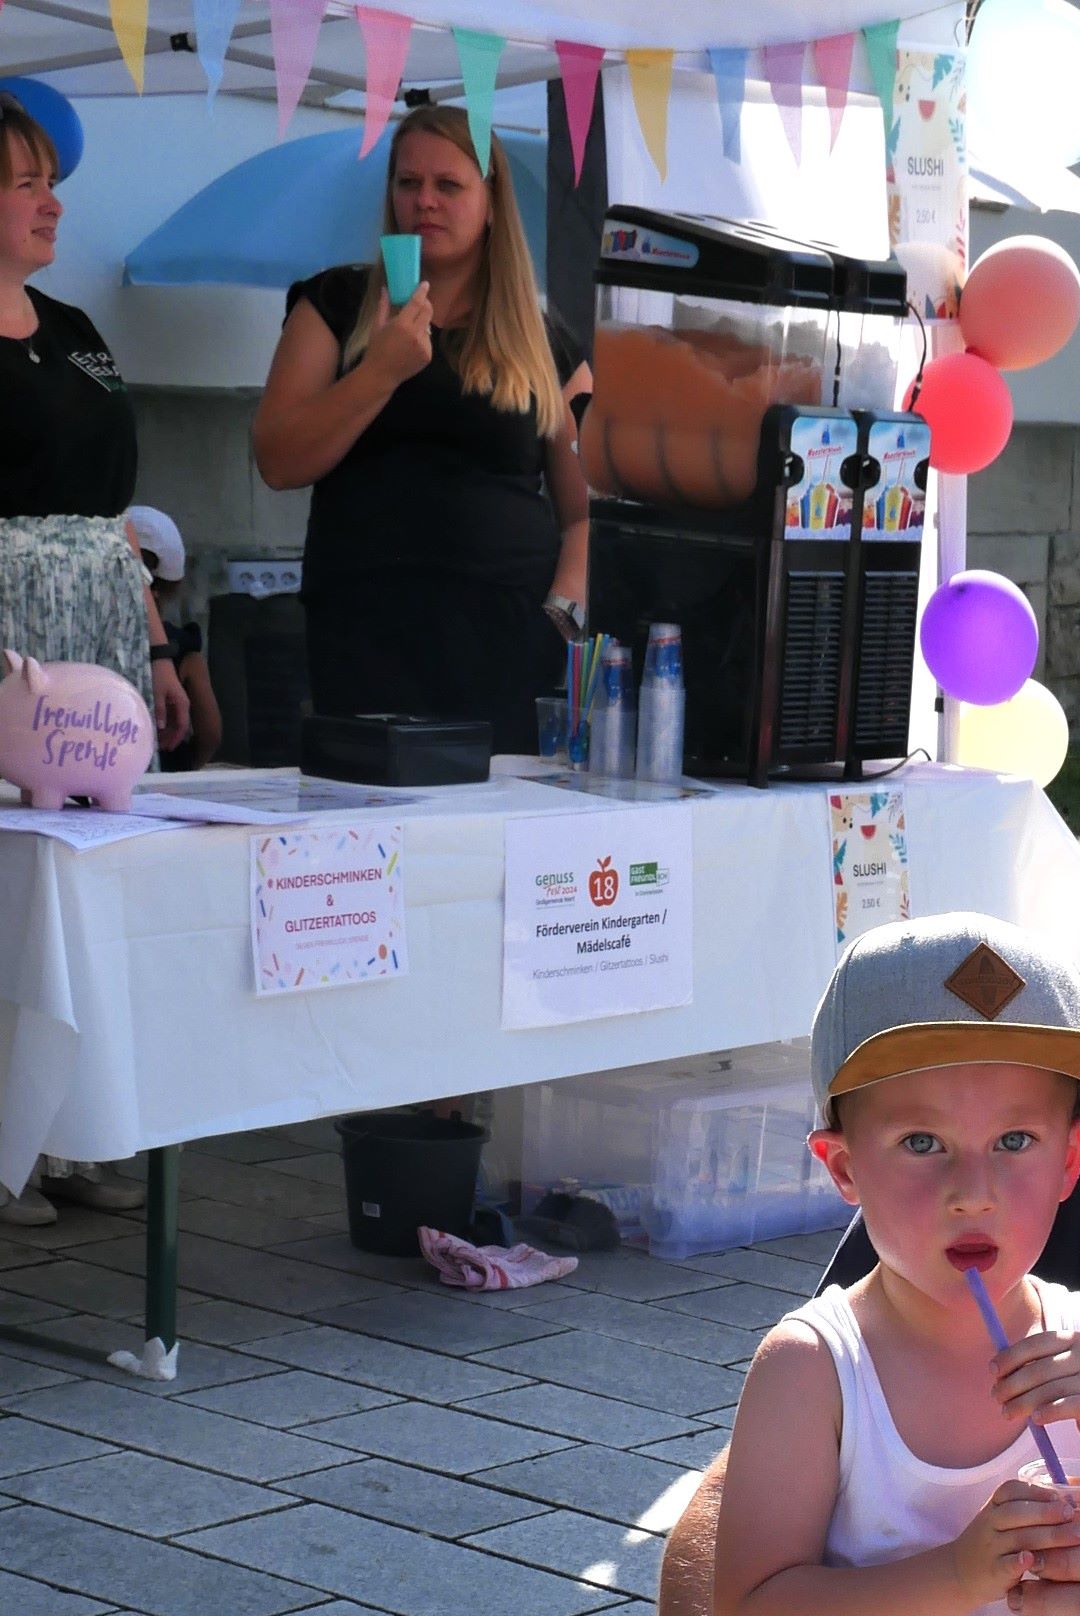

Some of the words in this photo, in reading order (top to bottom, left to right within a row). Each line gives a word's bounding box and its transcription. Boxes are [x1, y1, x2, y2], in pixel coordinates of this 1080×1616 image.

[907, 156, 944, 176] SLUSHI
[42, 729, 117, 771] Spende
[276, 868, 382, 890] KINDERSCHMINKEN
[853, 862, 887, 877] SLUSHI
[593, 876, 615, 901] 18
[326, 894, 334, 907] &
[284, 911, 377, 933] GLITZERTATTOOS
[536, 918, 599, 938] Förderverein
[601, 912, 660, 931] Kindergarten
[661, 908, 667, 925] /
[576, 934, 631, 954] Mädelscafé
[532, 963, 593, 980] Kinderschminken
[649, 953, 669, 965] Slushi
